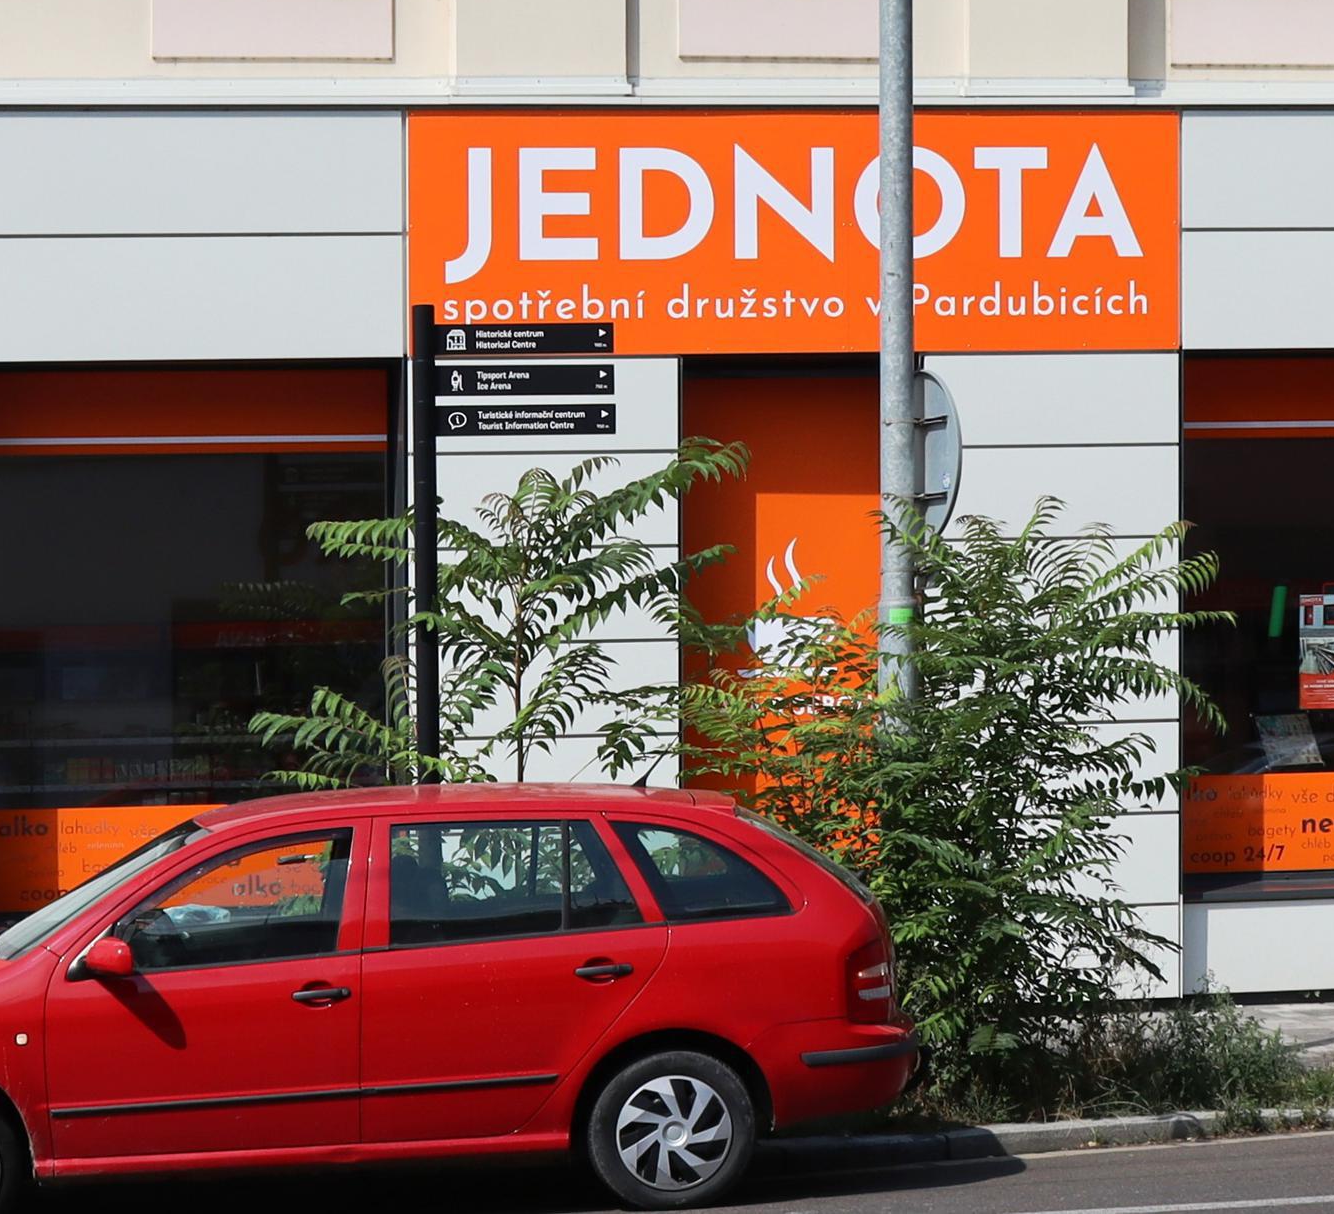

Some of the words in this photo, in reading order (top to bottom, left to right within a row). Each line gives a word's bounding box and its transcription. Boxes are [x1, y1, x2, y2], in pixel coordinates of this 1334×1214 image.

[445, 142, 1144, 284] JEDNOTA
[443, 284, 645, 325] spotřební
[667, 282, 844, 320] družstvo
[866, 297, 882, 317] v
[913, 279, 1149, 317] Pardubicích
[475, 329, 512, 339] Historické
[513, 330, 544, 338] centrum
[475, 340, 510, 349] Historical
[512, 340, 537, 349] Centre
[476, 371, 507, 381] Tipsport
[508, 371, 530, 379] Arena
[477, 382, 488, 390] Ice
[490, 382, 511, 390] Arena
[478, 410, 513, 419] Turistické
[515, 410, 553, 419] informační
[478, 421, 503, 430] Tourist
[505, 421, 548, 430] Information
[550, 421, 574, 429] Centre
[1291, 787, 1318, 804] vše
[1248, 824, 1296, 839] bagety
[1190, 849, 1236, 866] coop
[1244, 844, 1286, 862] 24/7
